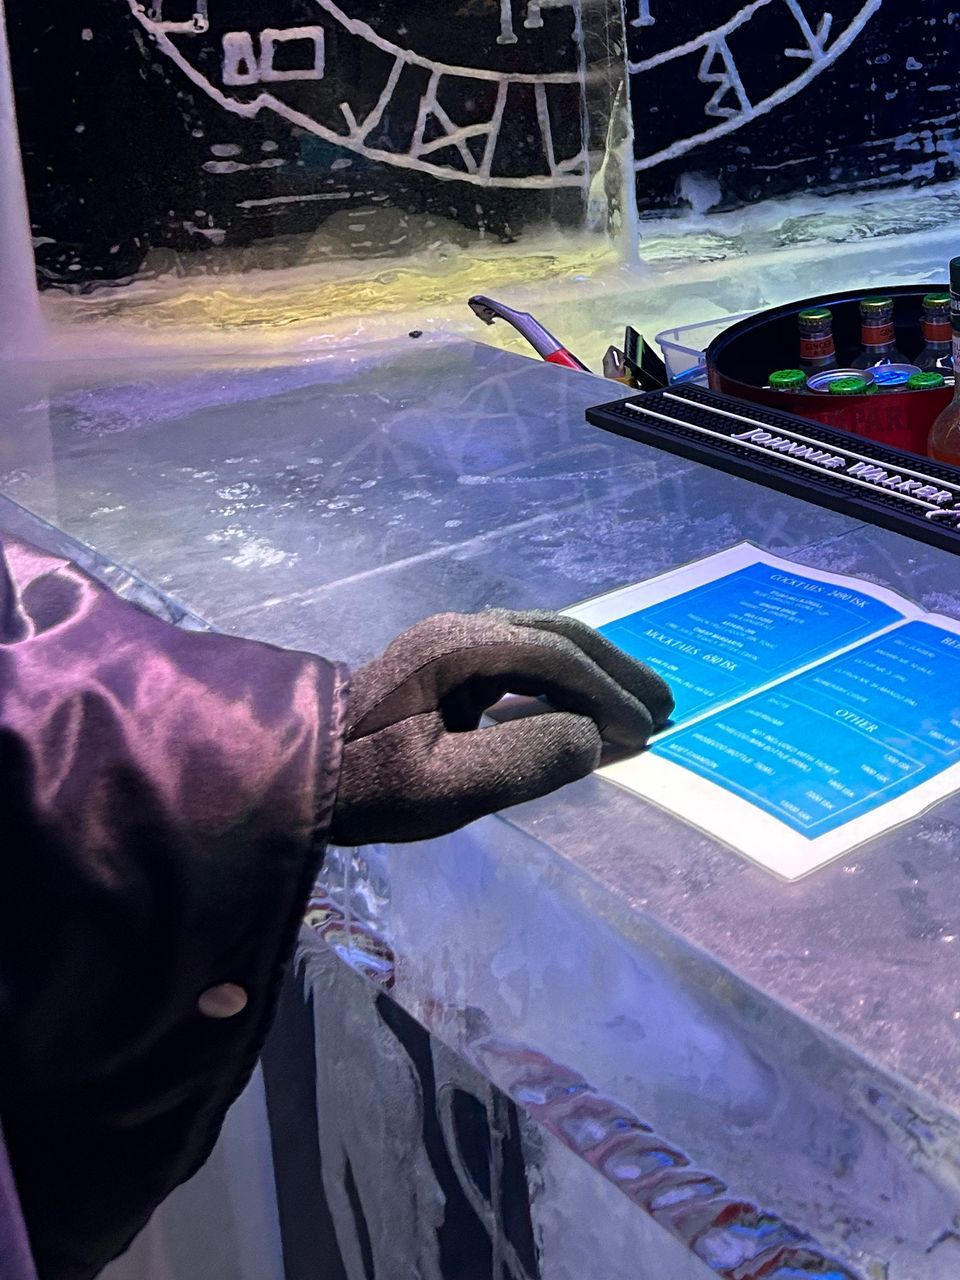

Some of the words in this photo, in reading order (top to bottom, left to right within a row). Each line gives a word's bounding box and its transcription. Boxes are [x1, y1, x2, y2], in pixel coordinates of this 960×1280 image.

[731, 427, 846, 469] JOHNNIE
[847, 461, 953, 504] WALKER
[770, 573, 823, 593] COCKTAILS
[643, 628, 699, 655] MOCKTAILS
[834, 708, 878, 733] OTHER
